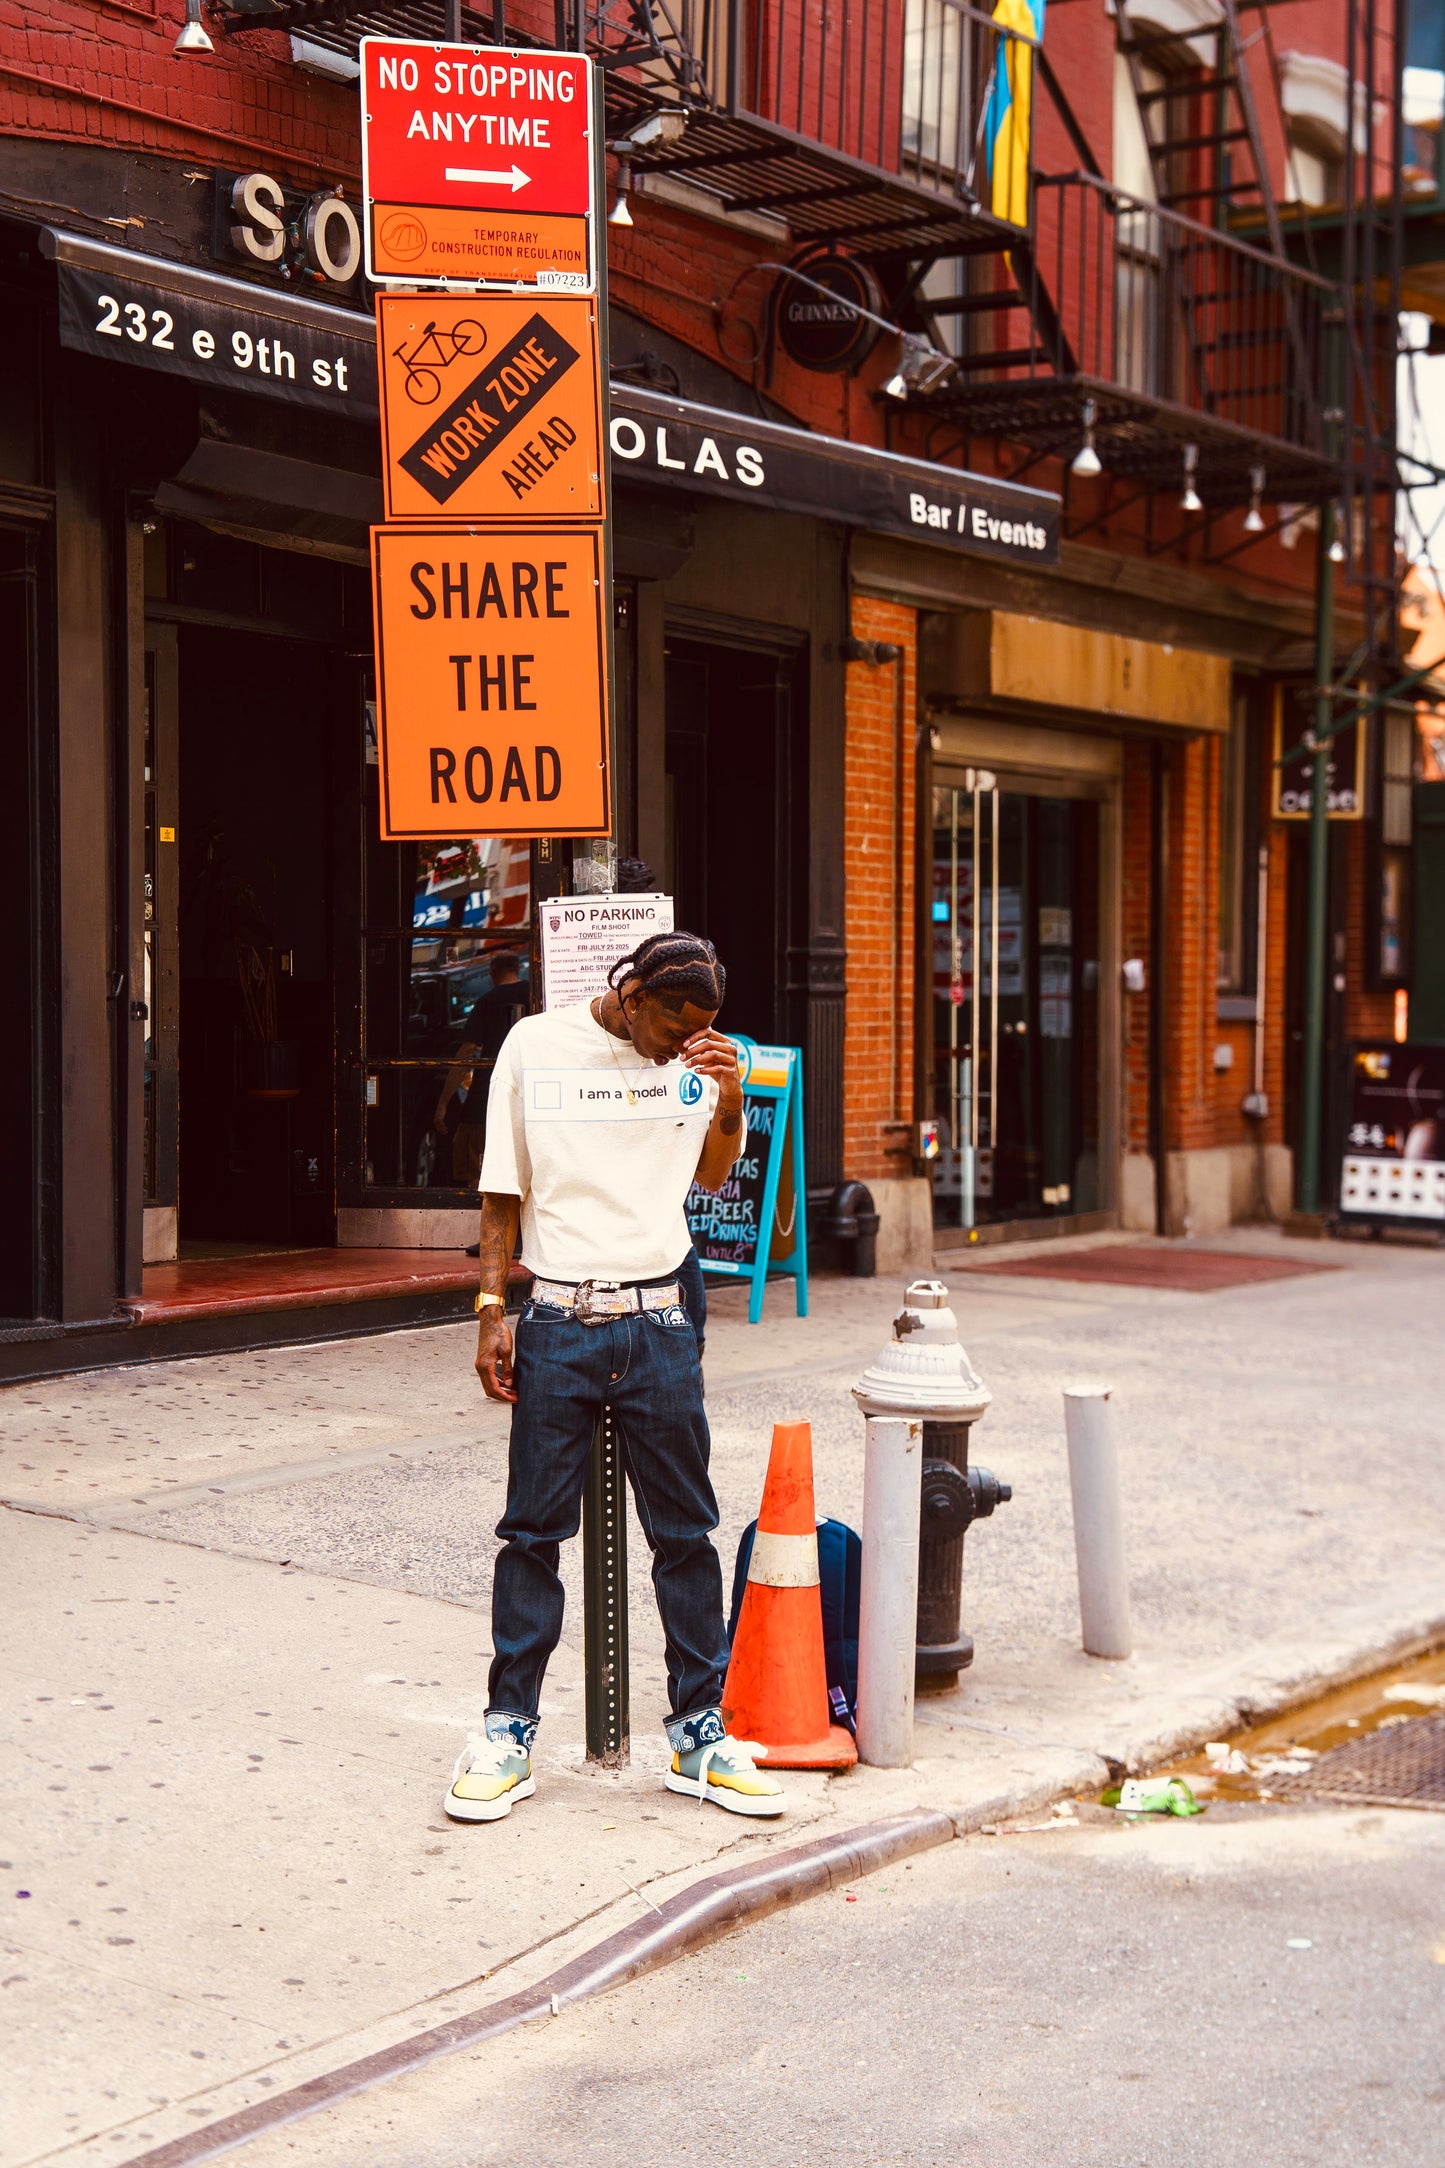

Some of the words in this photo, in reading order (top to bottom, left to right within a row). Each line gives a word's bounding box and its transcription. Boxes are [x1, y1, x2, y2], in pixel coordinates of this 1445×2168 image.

[380, 57, 419, 92] NO
[435, 62, 574, 102] STOPPING
[407, 110, 551, 148] ANYTIME
[432, 242, 513, 257] CONSTRUCTION
[517, 247, 581, 262] REGULATION
[474, 229, 539, 244] TEMPORARY
[539, 273, 585, 288] #07223
[788, 301, 859, 322] GUINNESS
[96, 296, 174, 350] 232
[192, 329, 215, 359] e
[232, 330, 296, 379] 9th
[312, 357, 348, 392] st
[421, 400, 499, 478] WORK
[486, 337, 558, 412] ZONE
[502, 417, 577, 499] AHEAD
[610, 417, 765, 487] OLAS
[910, 492, 952, 530] Bar
[957, 504, 967, 534] /
[972, 507, 1047, 550] Events
[411, 562, 570, 619] SHARE
[449, 655, 537, 711] THE
[429, 746, 562, 803] ROAD
[565, 910, 586, 922] NO
[590, 908, 656, 921] PARKING
[579, 1088, 583, 1099] I
[587, 1090, 611, 1099] am
[614, 1090, 622, 1099] a
[712, 1198, 754, 1223] BEER
[708, 1220, 758, 1243] DRINKS
[706, 1245, 732, 1260] UNTIL
